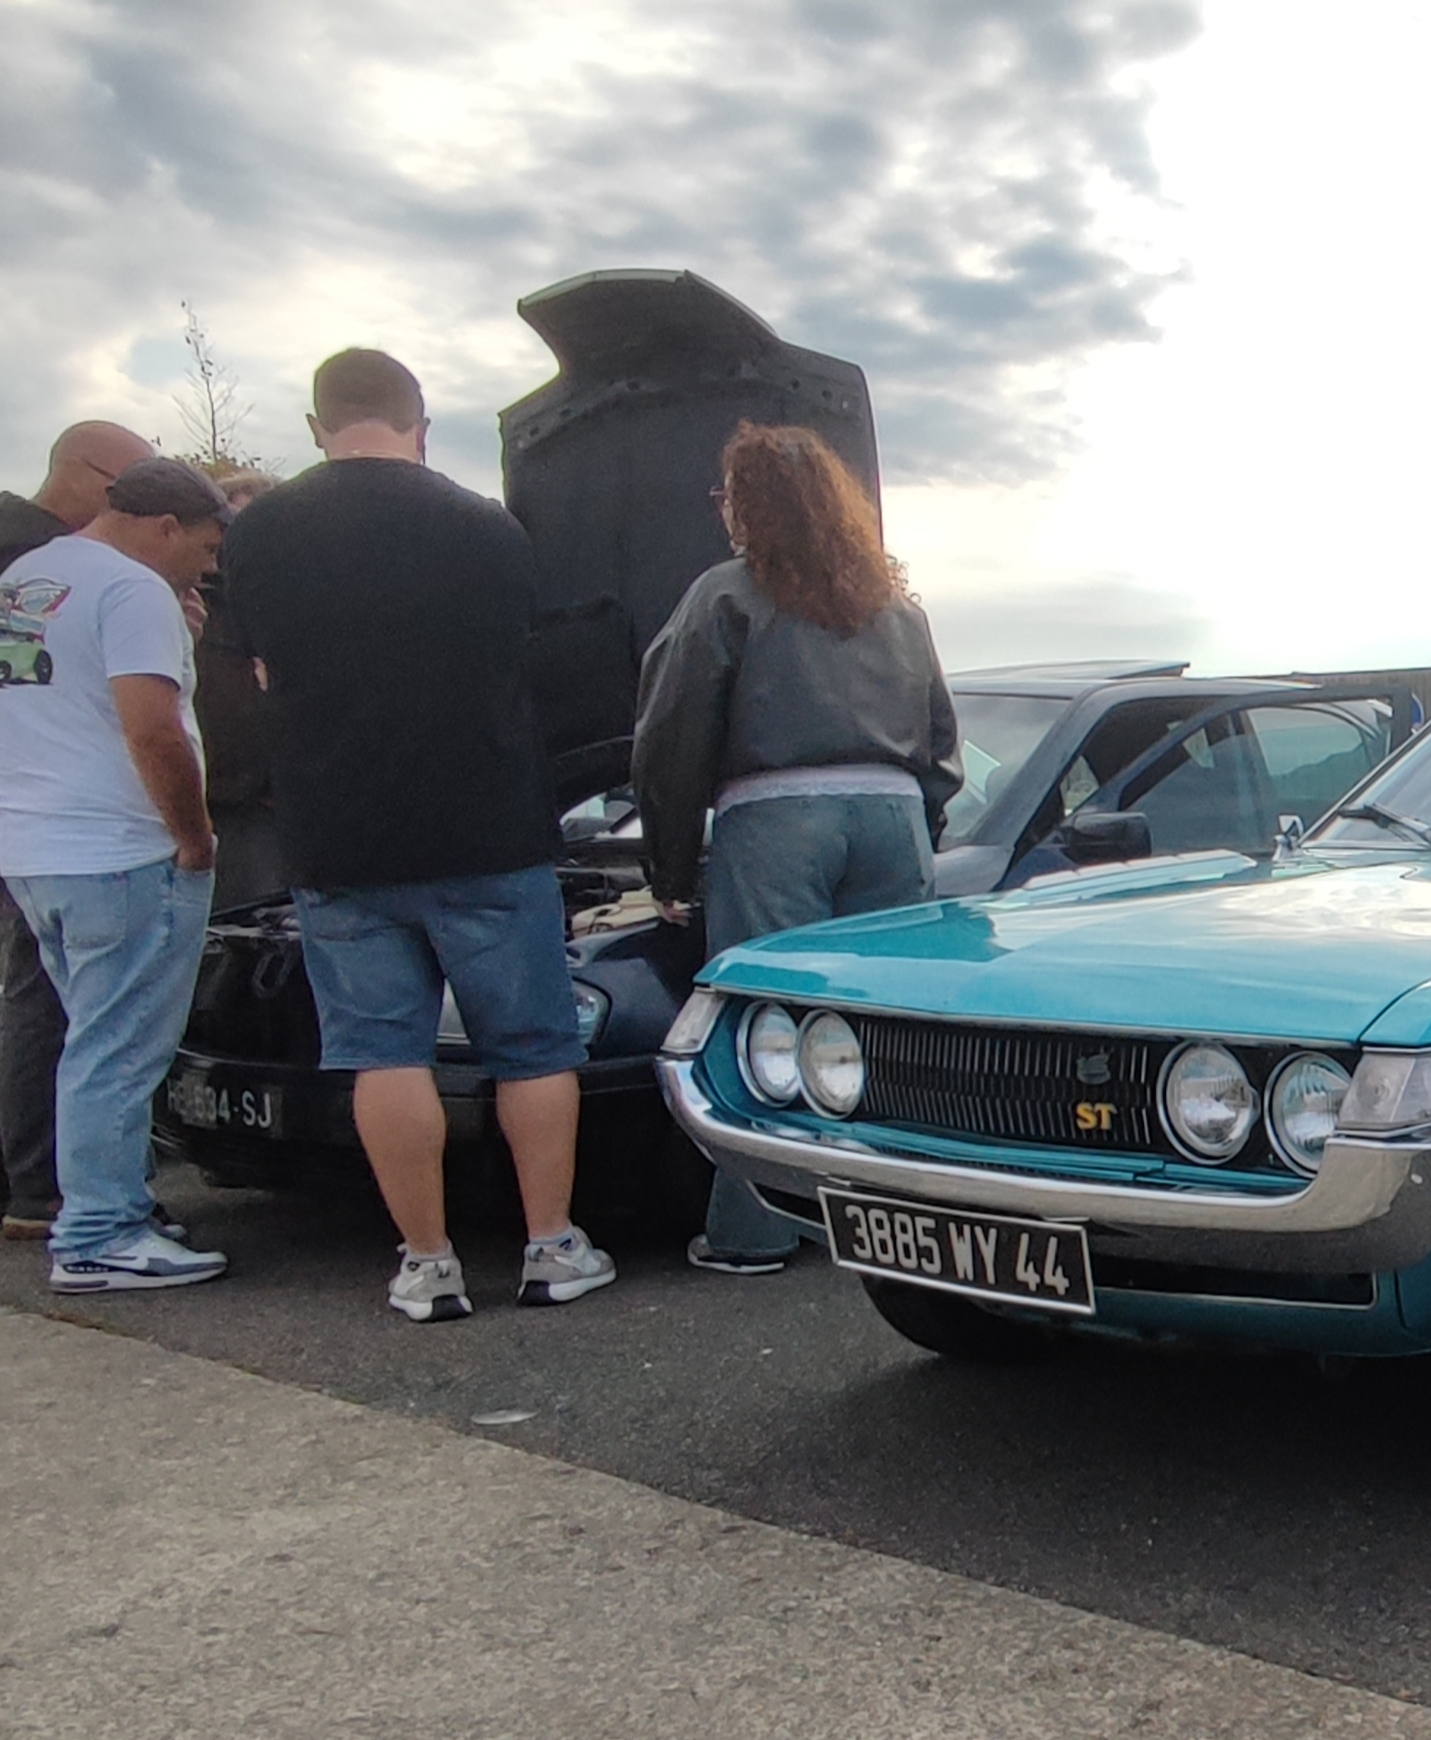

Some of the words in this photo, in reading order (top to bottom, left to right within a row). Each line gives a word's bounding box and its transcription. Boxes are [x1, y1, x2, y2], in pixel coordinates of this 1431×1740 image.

[1076, 1102, 1118, 1130] ST
[845, 1205, 942, 1275] 3885
[949, 1222, 997, 1285] WY
[1016, 1233, 1070, 1296] 44
